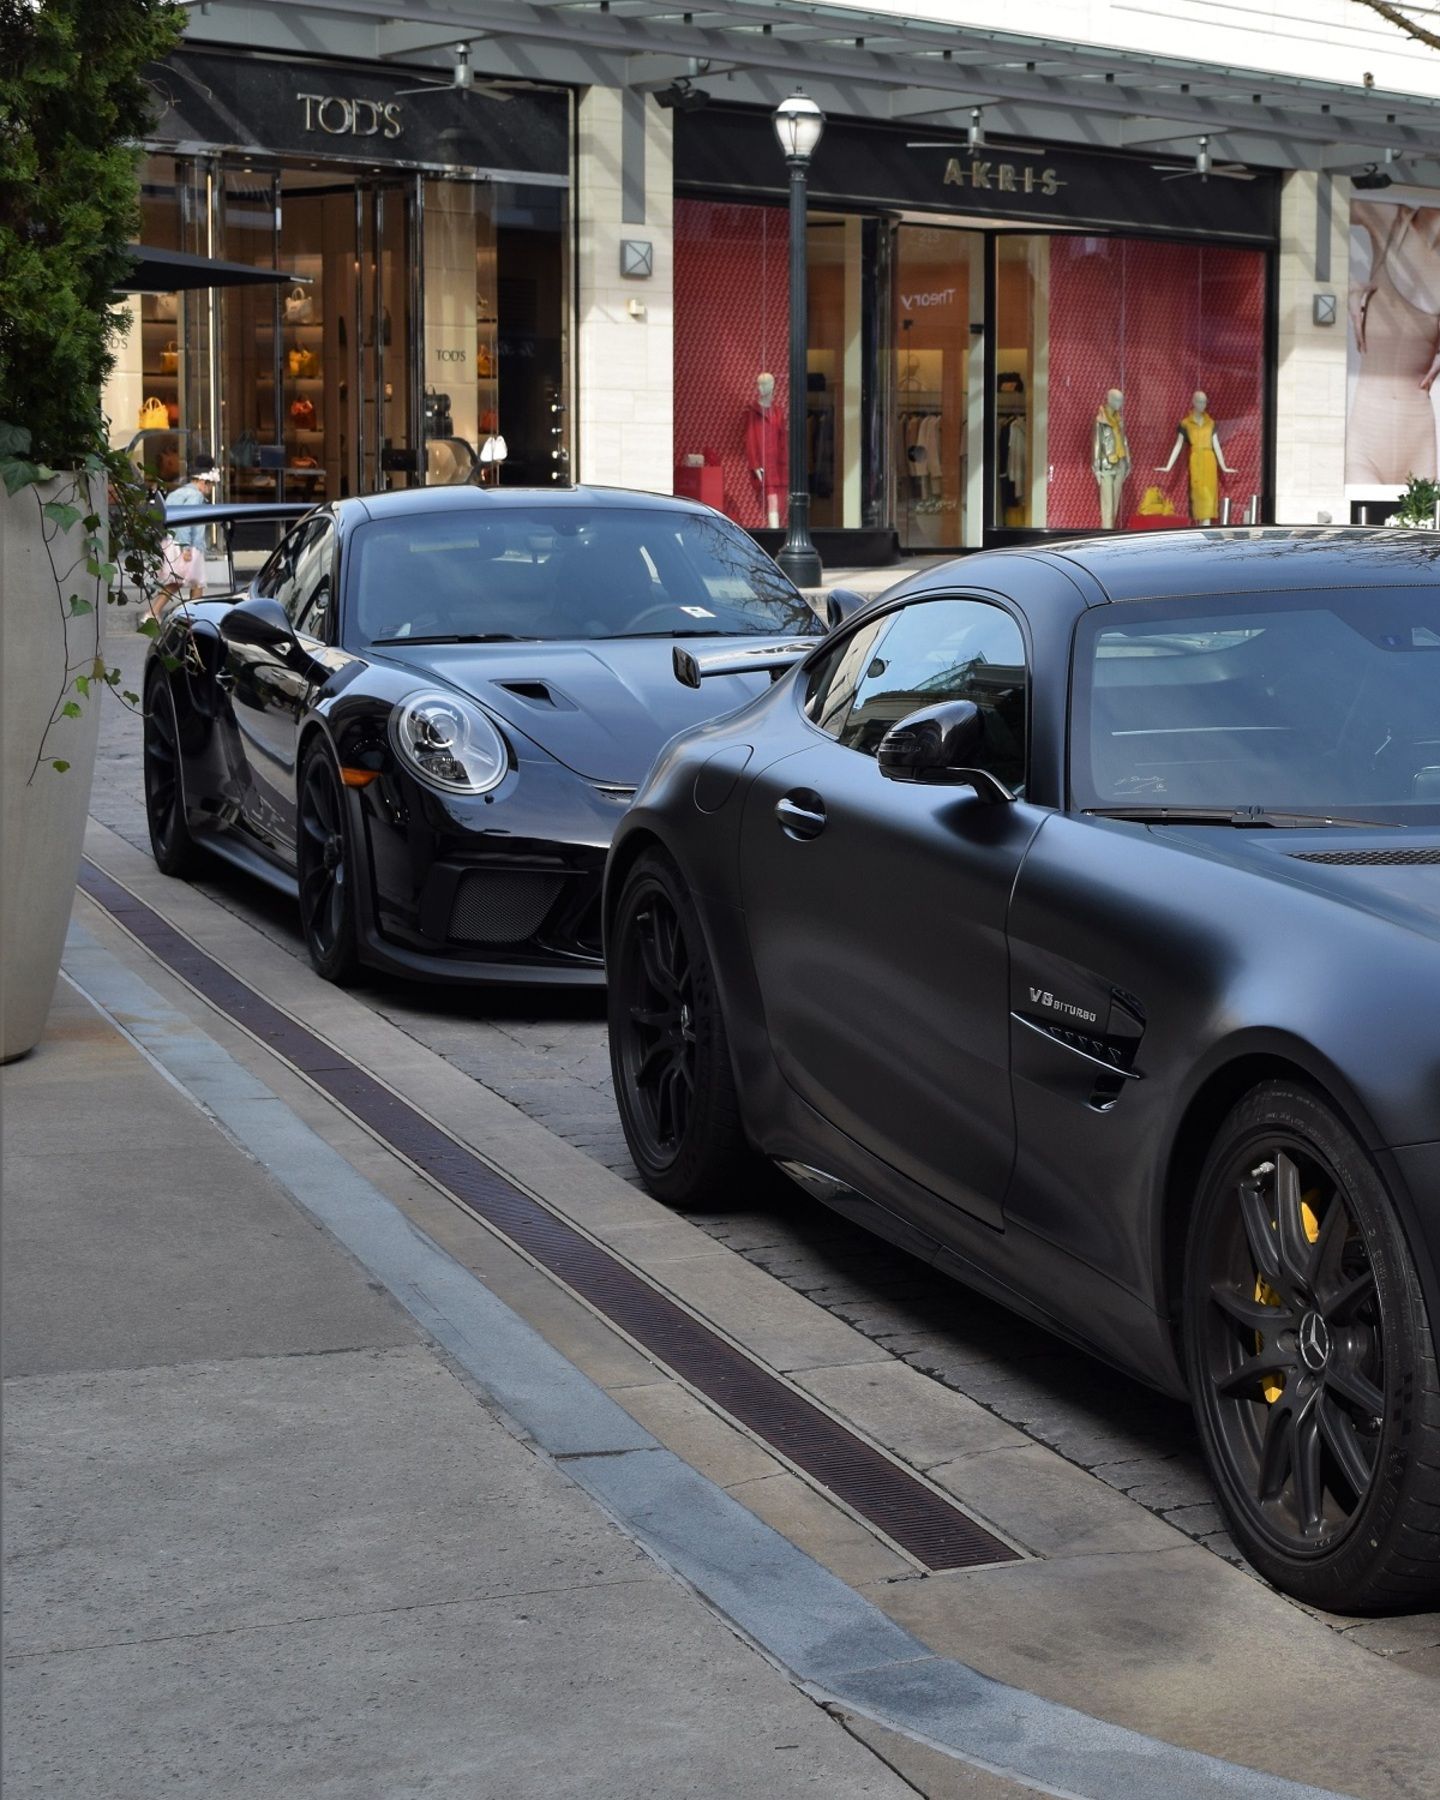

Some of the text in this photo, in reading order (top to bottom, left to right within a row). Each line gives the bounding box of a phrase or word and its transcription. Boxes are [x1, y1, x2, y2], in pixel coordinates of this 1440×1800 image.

[296, 92, 401, 139] TOD'S
[943, 158, 1062, 196] AKRIS
[436, 348, 466, 362] TOD'S
[1029, 986, 1097, 1022] V8 BITURBO
